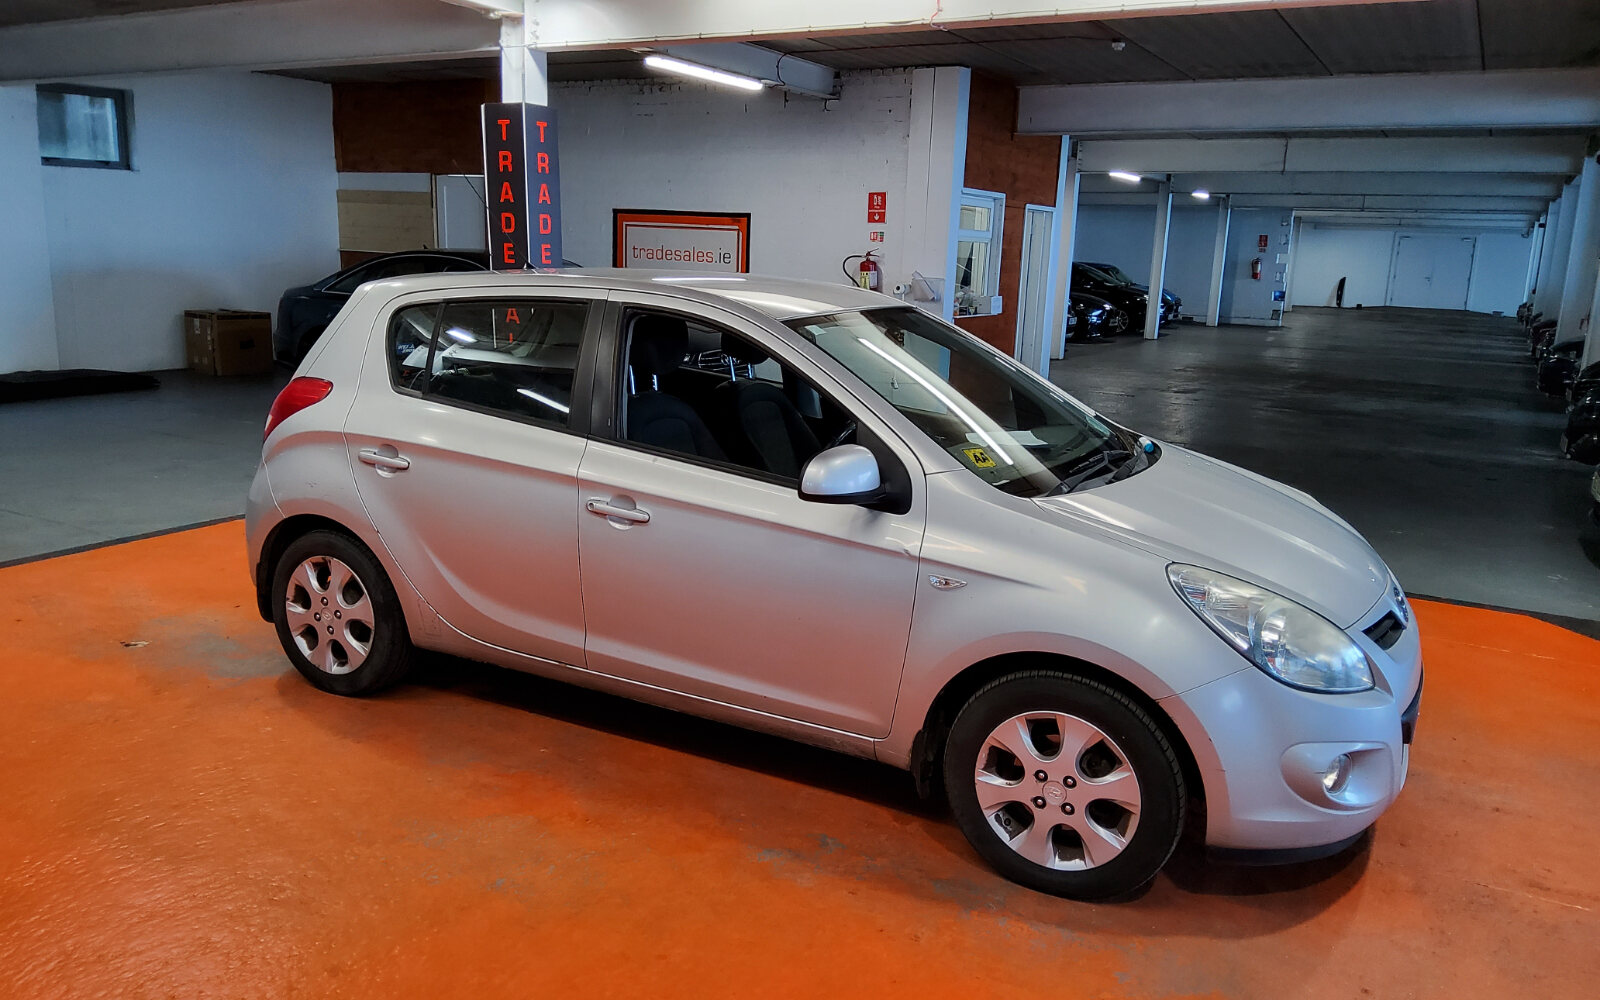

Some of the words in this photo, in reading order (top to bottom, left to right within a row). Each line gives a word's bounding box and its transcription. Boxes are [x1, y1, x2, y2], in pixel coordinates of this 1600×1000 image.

[498, 119, 515, 264] TRADE
[536, 121, 551, 264] TRADE
[632, 245, 731, 264] tradesales.ie
[973, 452, 990, 463] AA
